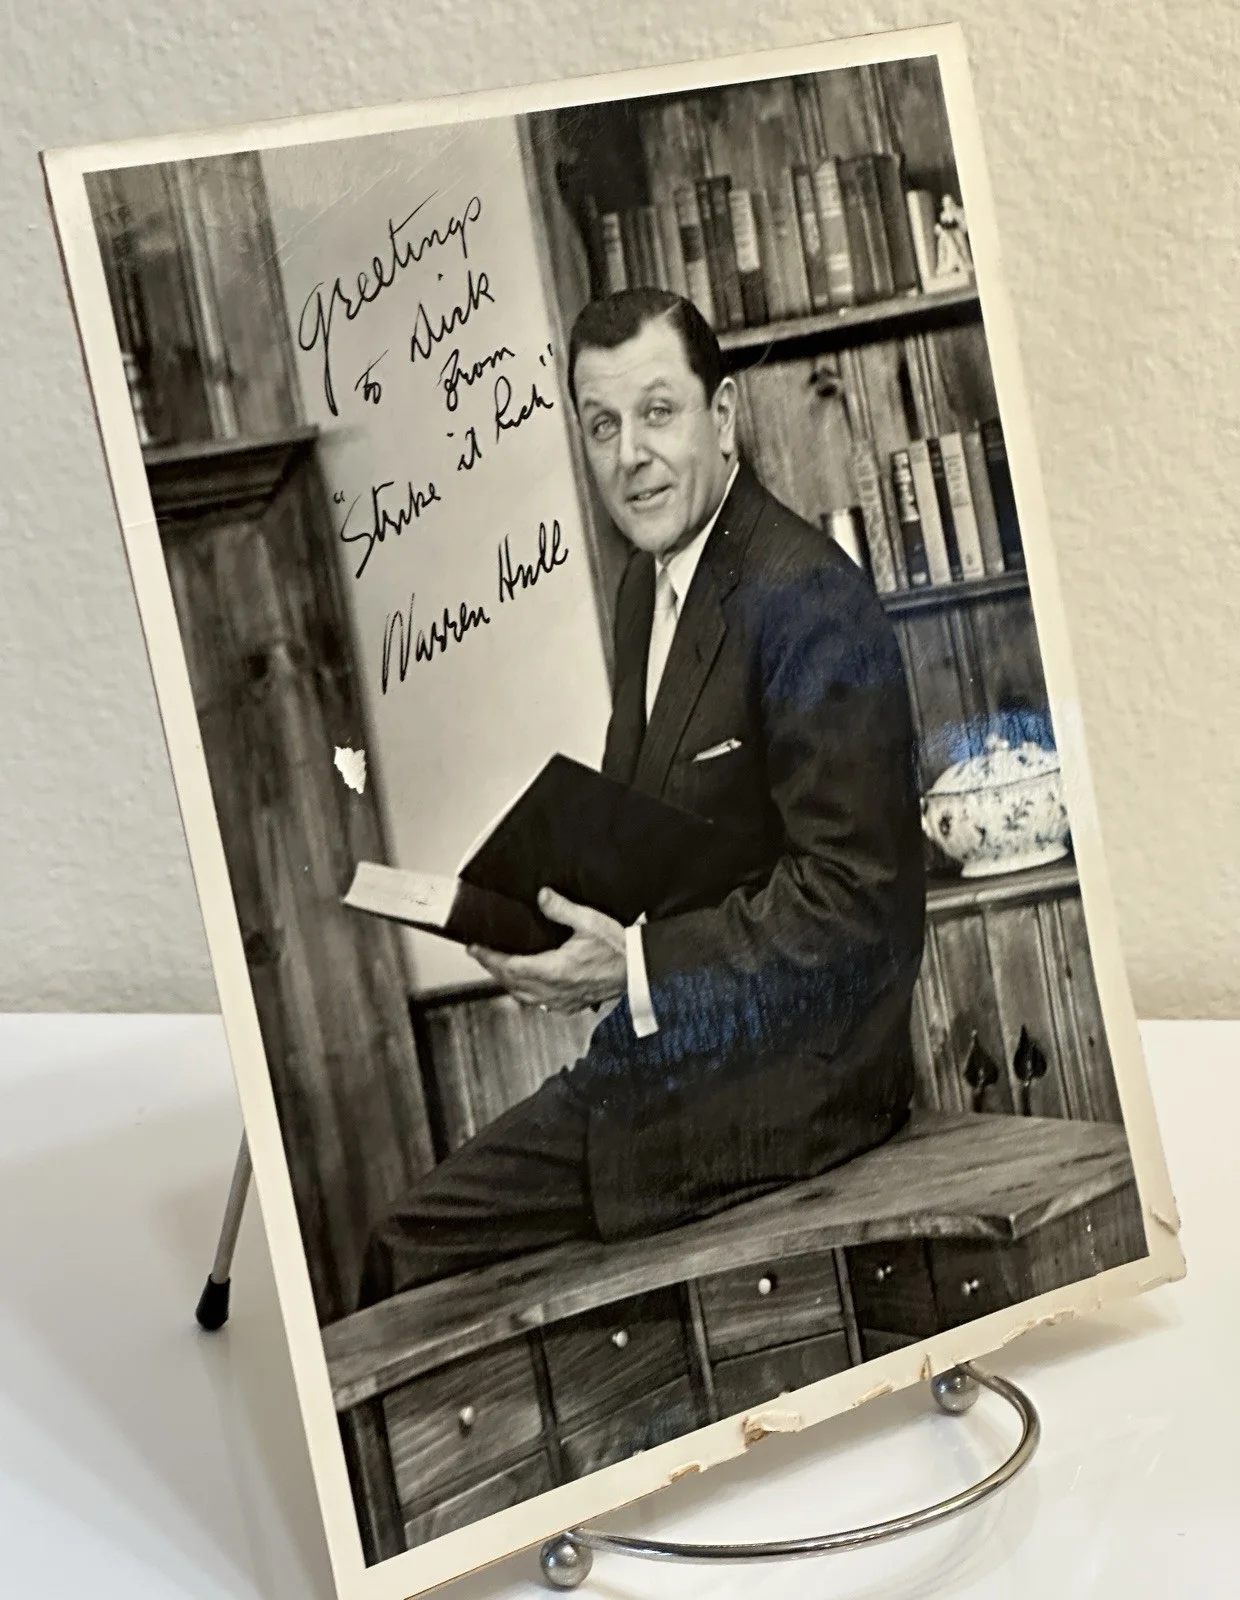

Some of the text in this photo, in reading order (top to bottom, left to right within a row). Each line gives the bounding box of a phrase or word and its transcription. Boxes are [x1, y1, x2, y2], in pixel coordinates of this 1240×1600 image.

[438, 347, 515, 411] from
[447, 427, 482, 472] it
[382, 519, 568, 696] Warren Hull
